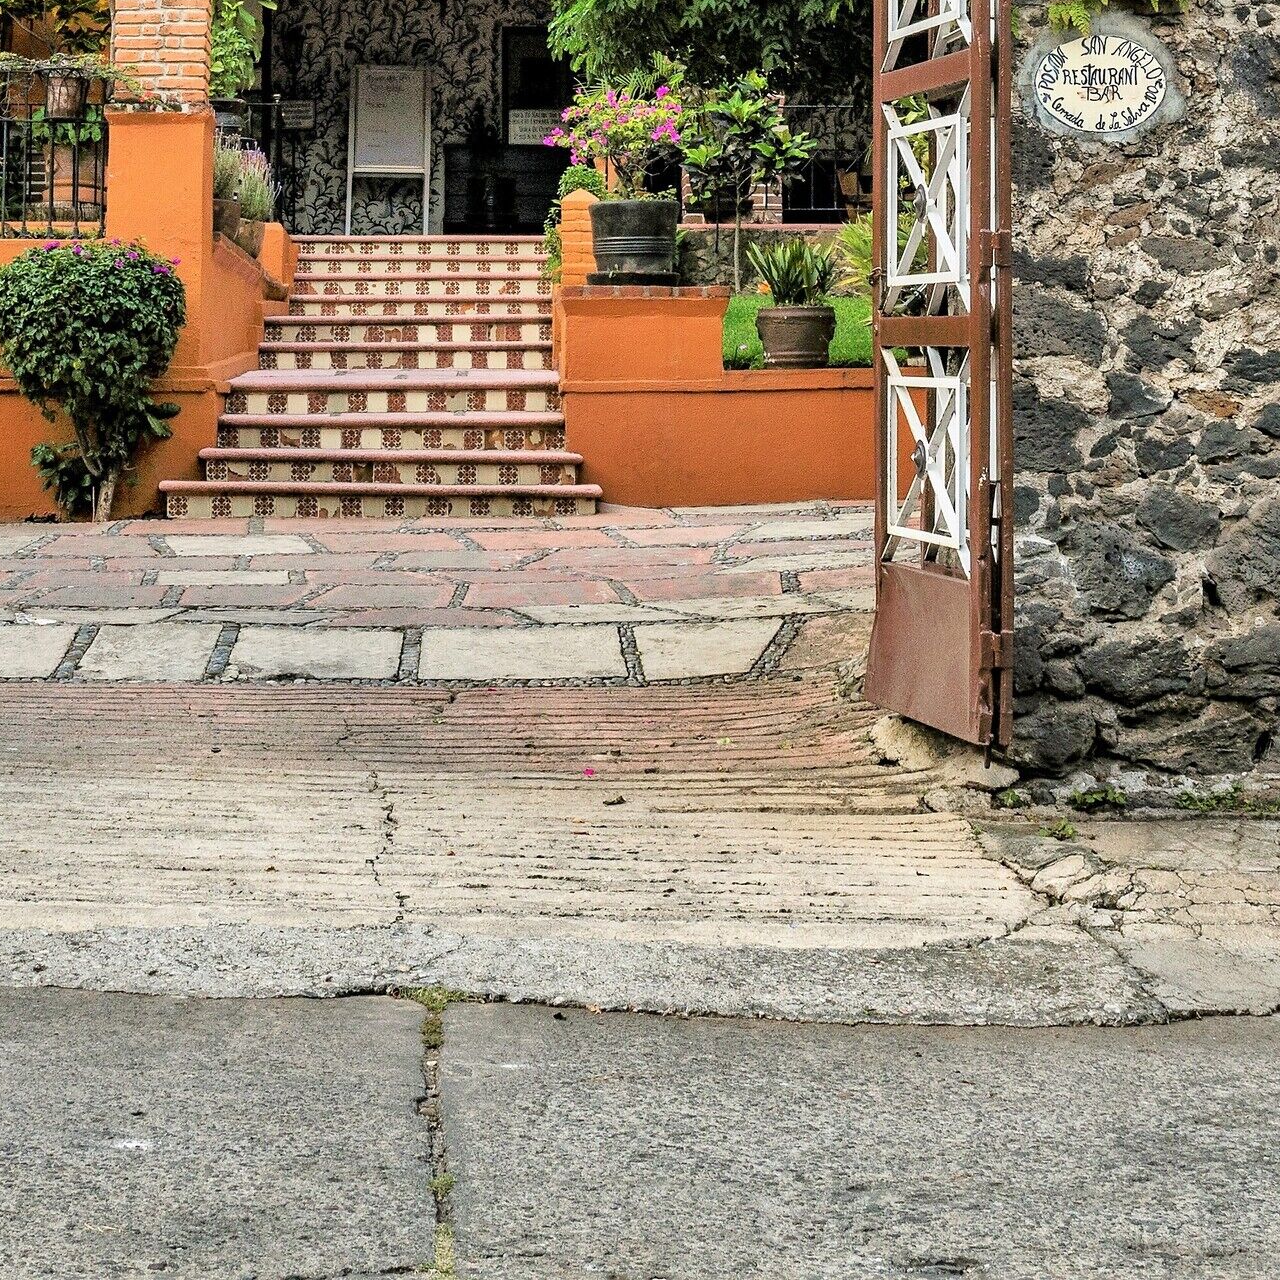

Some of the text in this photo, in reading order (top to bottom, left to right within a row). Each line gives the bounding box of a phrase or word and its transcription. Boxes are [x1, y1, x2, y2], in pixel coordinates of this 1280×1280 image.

[1038, 35, 1164, 91] POSADA SAN ANGELO
[1063, 63, 1139, 86] RESTAURANT
[1081, 85, 1123, 103] BAR
[1095, 114, 1106, 131] de
